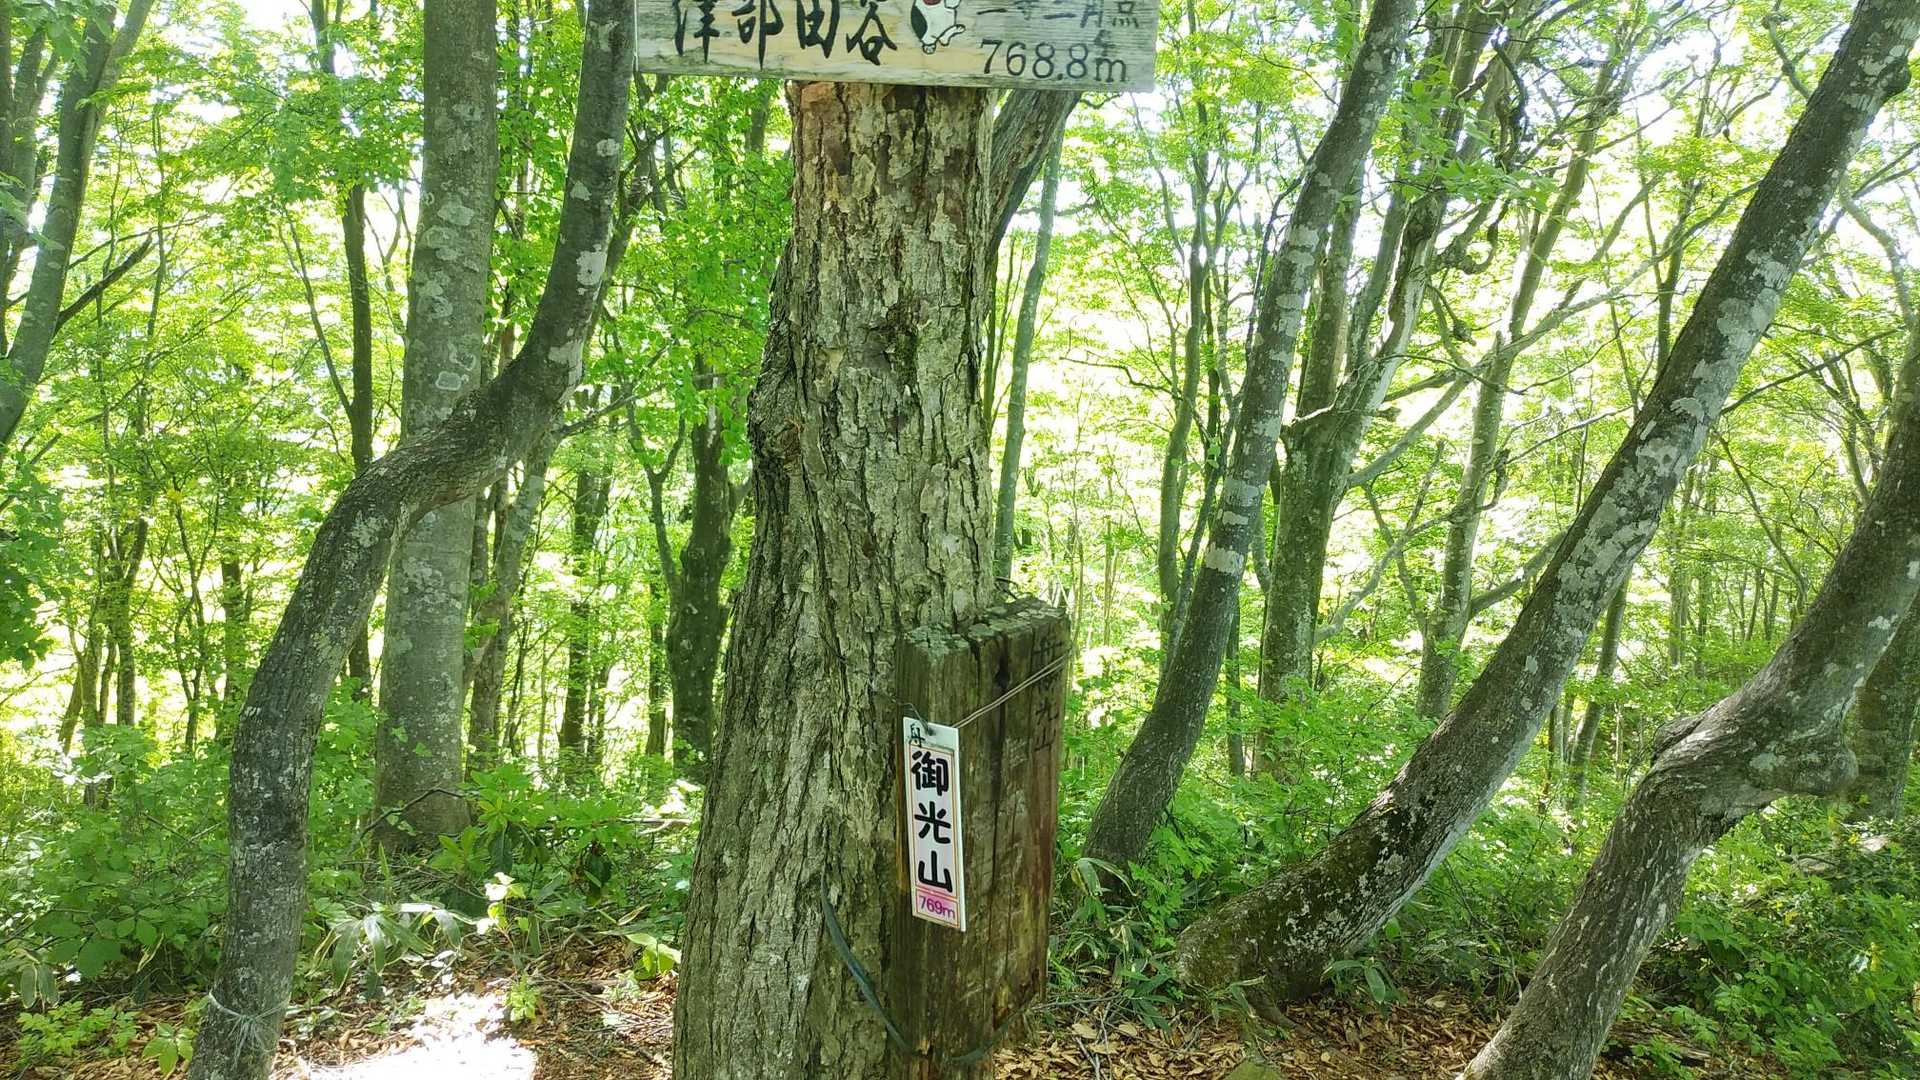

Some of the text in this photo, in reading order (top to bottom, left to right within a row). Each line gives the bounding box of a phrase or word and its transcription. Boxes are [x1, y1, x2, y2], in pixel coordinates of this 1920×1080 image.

[980, 38, 1127, 82] 768.8m
[911, 750, 953, 893] 御光山
[919, 895, 956, 920] 769m
